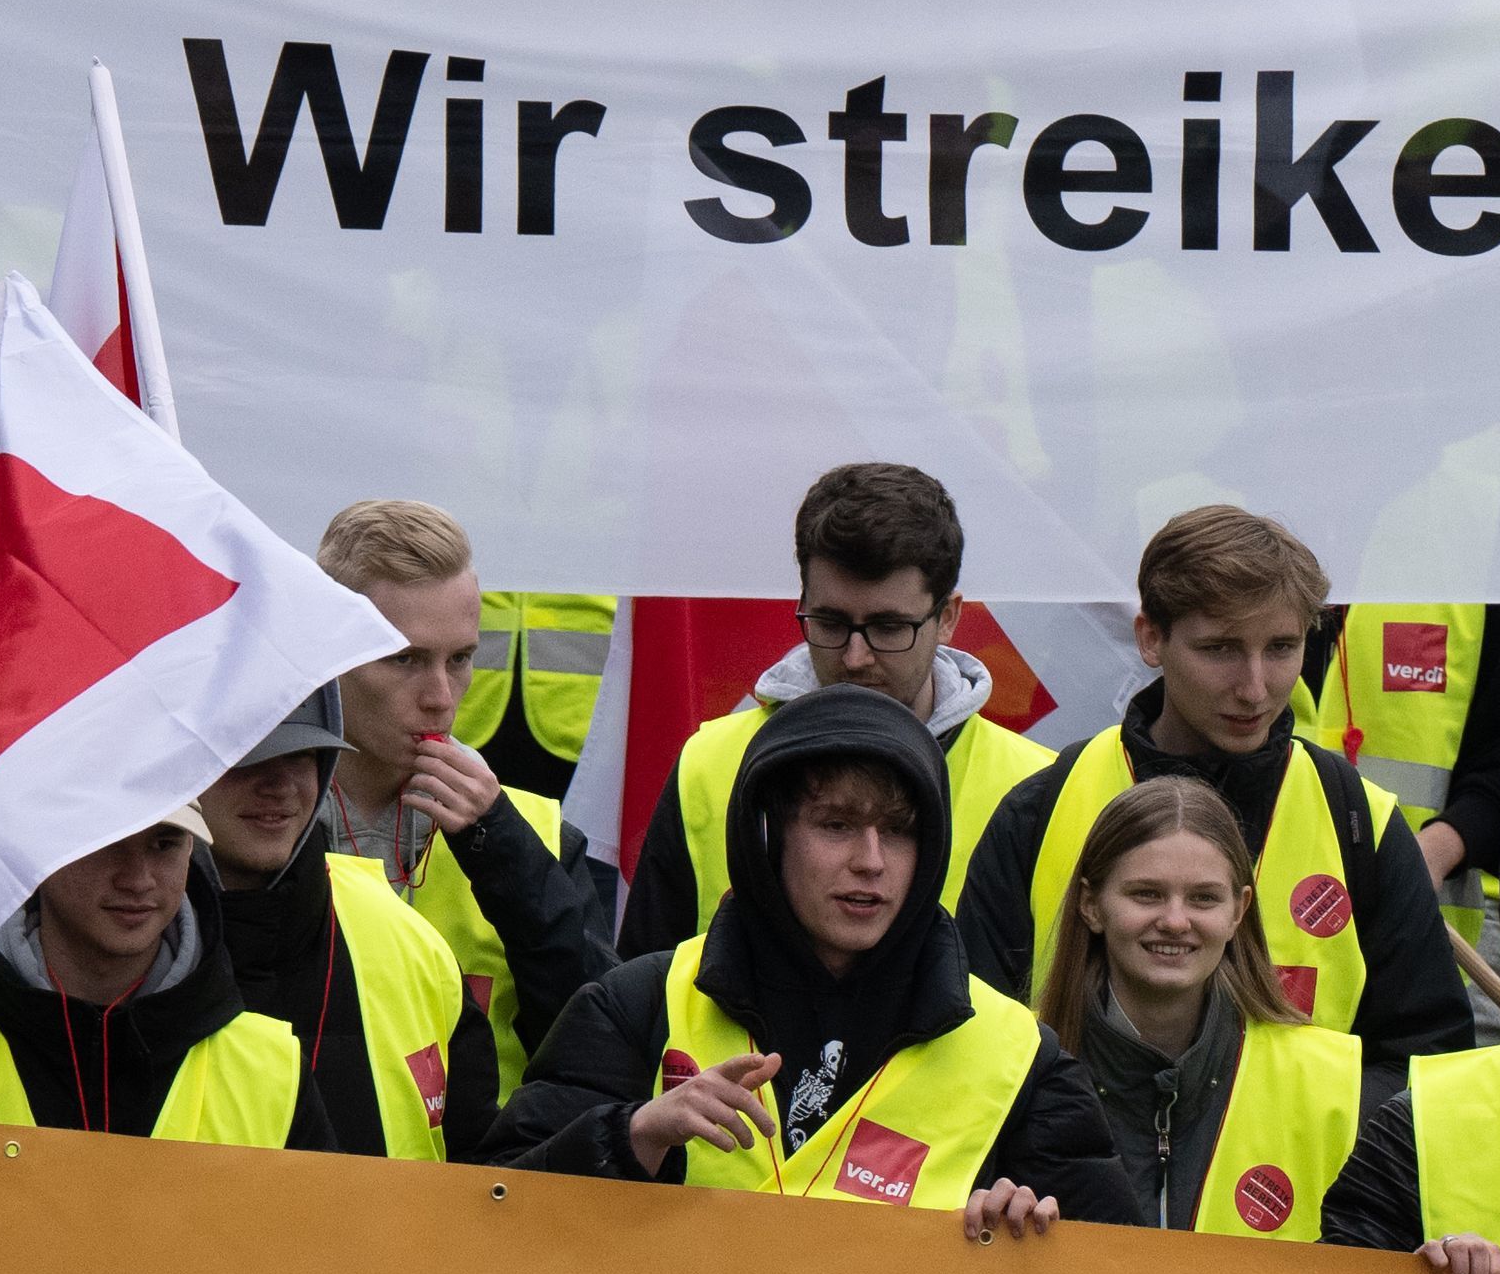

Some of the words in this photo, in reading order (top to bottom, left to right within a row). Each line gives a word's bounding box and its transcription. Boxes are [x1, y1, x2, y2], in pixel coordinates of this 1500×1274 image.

[183, 37, 607, 236] Wir
[1387, 658, 1444, 686] ver.di
[1293, 879, 1332, 916] STREIK
[1304, 889, 1340, 927] BEREIT
[845, 1161, 911, 1199] ver.di
[1242, 1180, 1284, 1218] BEREIT
[1251, 1170, 1291, 1207] STREIK
